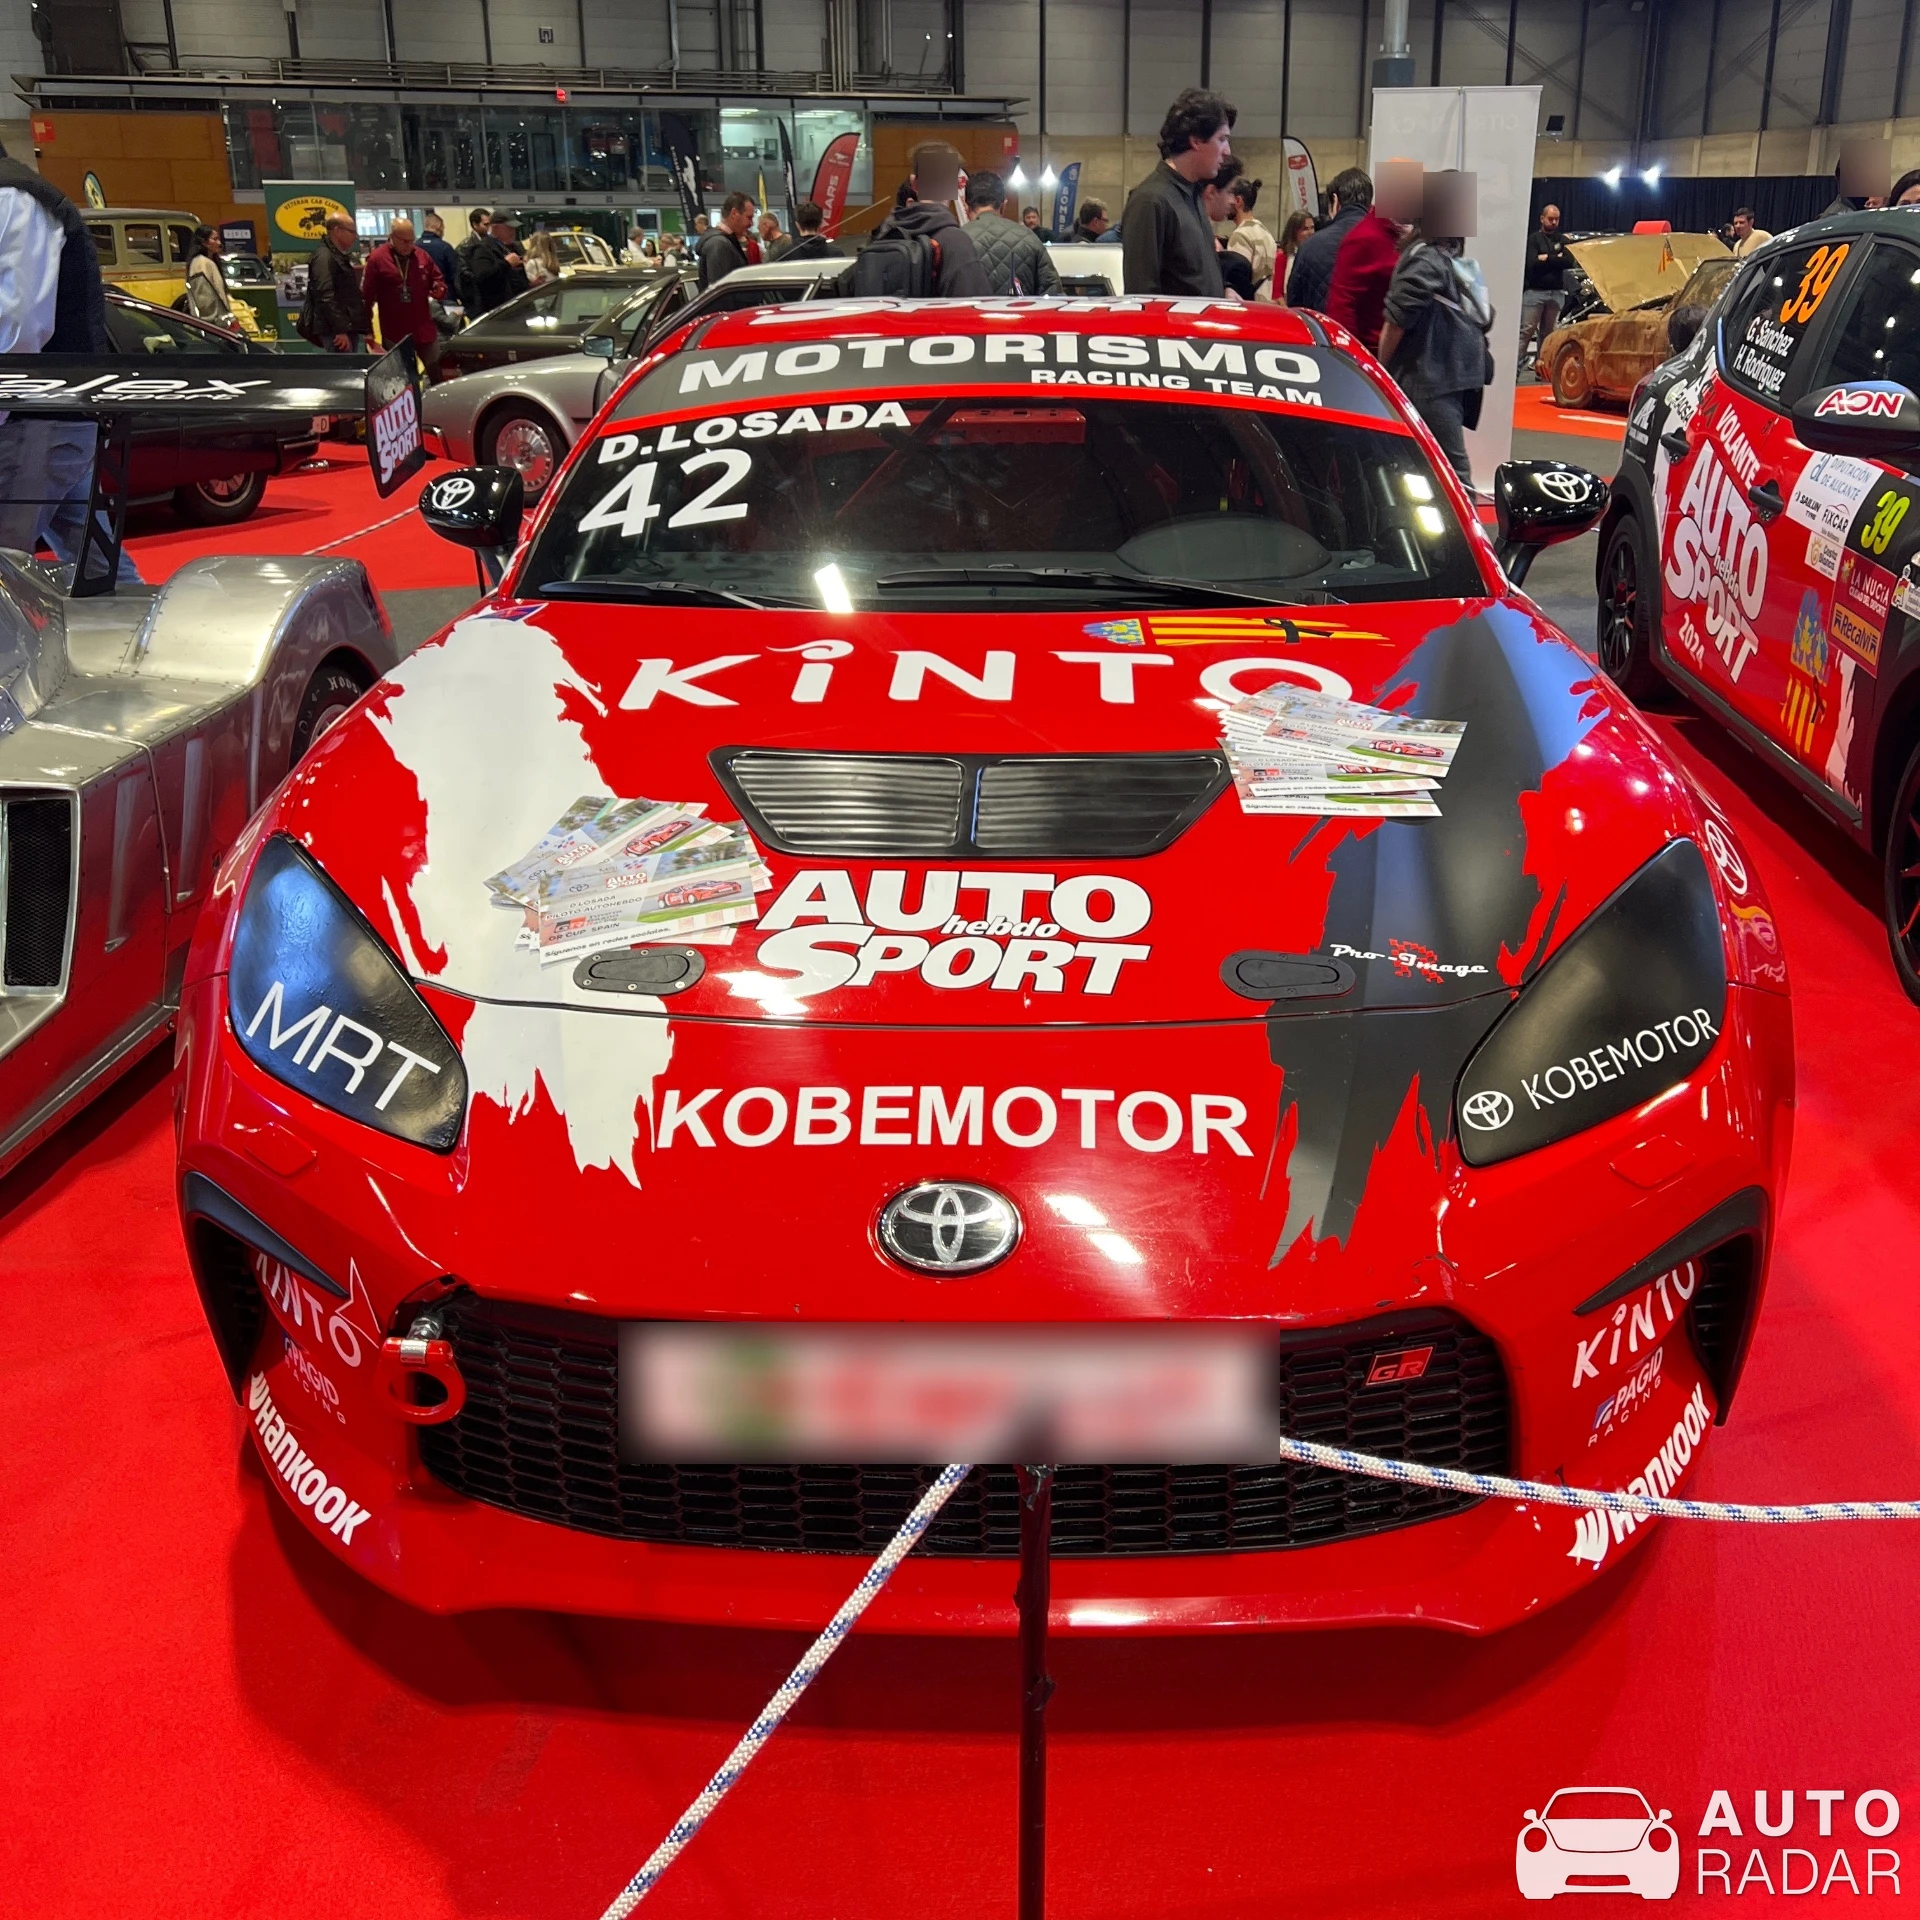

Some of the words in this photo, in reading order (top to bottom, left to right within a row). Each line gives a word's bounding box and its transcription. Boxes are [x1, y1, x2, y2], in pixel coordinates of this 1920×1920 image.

[284, 199, 308, 210] VETERAN
[325, 200, 339, 211] CLUB
[1780, 244, 1849, 323] 39
[678, 332, 1321, 393] MOTORISMO
[1746, 316, 1761, 342] G.
[1755, 319, 1795, 357] Sánchez
[1031, 369, 1190, 390] RACING
[1204, 379, 1323, 407] TEAM
[1733, 344, 1747, 370] H.
[1741, 348, 1787, 392] Rodríguez
[375, 389, 416, 453] AUTO
[597, 401, 911, 464] D.LOSADA
[1816, 389, 1904, 418] AON
[380, 421, 419, 485] SPORT
[1716, 403, 1761, 488] VOLANTE
[1830, 458, 1873, 483] DIPUTACIÓN
[577, 447, 752, 537] 42
[1820, 474, 1831, 487] DE
[1829, 477, 1862, 501] ALICANTE
[1678, 439, 1768, 622] AUTO
[1821, 508, 1849, 534] FIXCAR
[1861, 490, 1911, 555] 39
[1664, 516, 1759, 685] SPORT
[1713, 545, 1740, 599] hebdo
[1850, 568, 1861, 587] LA
[1678, 613, 1705, 670] 2024
[1840, 614, 1871, 651] Recalvi
[606, 872, 647, 885] AUTO
[755, 869, 1152, 938] AUTO
[591, 922, 621, 933] SPAIN
[941, 914, 1061, 938] hebdo
[755, 923, 1152, 998] SPORT
[245, 980, 442, 1112] MRT
[1520, 1008, 1720, 1111] KOBEMOTOR
[656, 1085, 1255, 1158] KOBEMOTOR
[291, 1344, 340, 1406] PAGID
[1371, 1359, 1426, 1381] GR
[1613, 1346, 1664, 1416] PAGID
[1588, 1374, 1662, 1447] RACING
